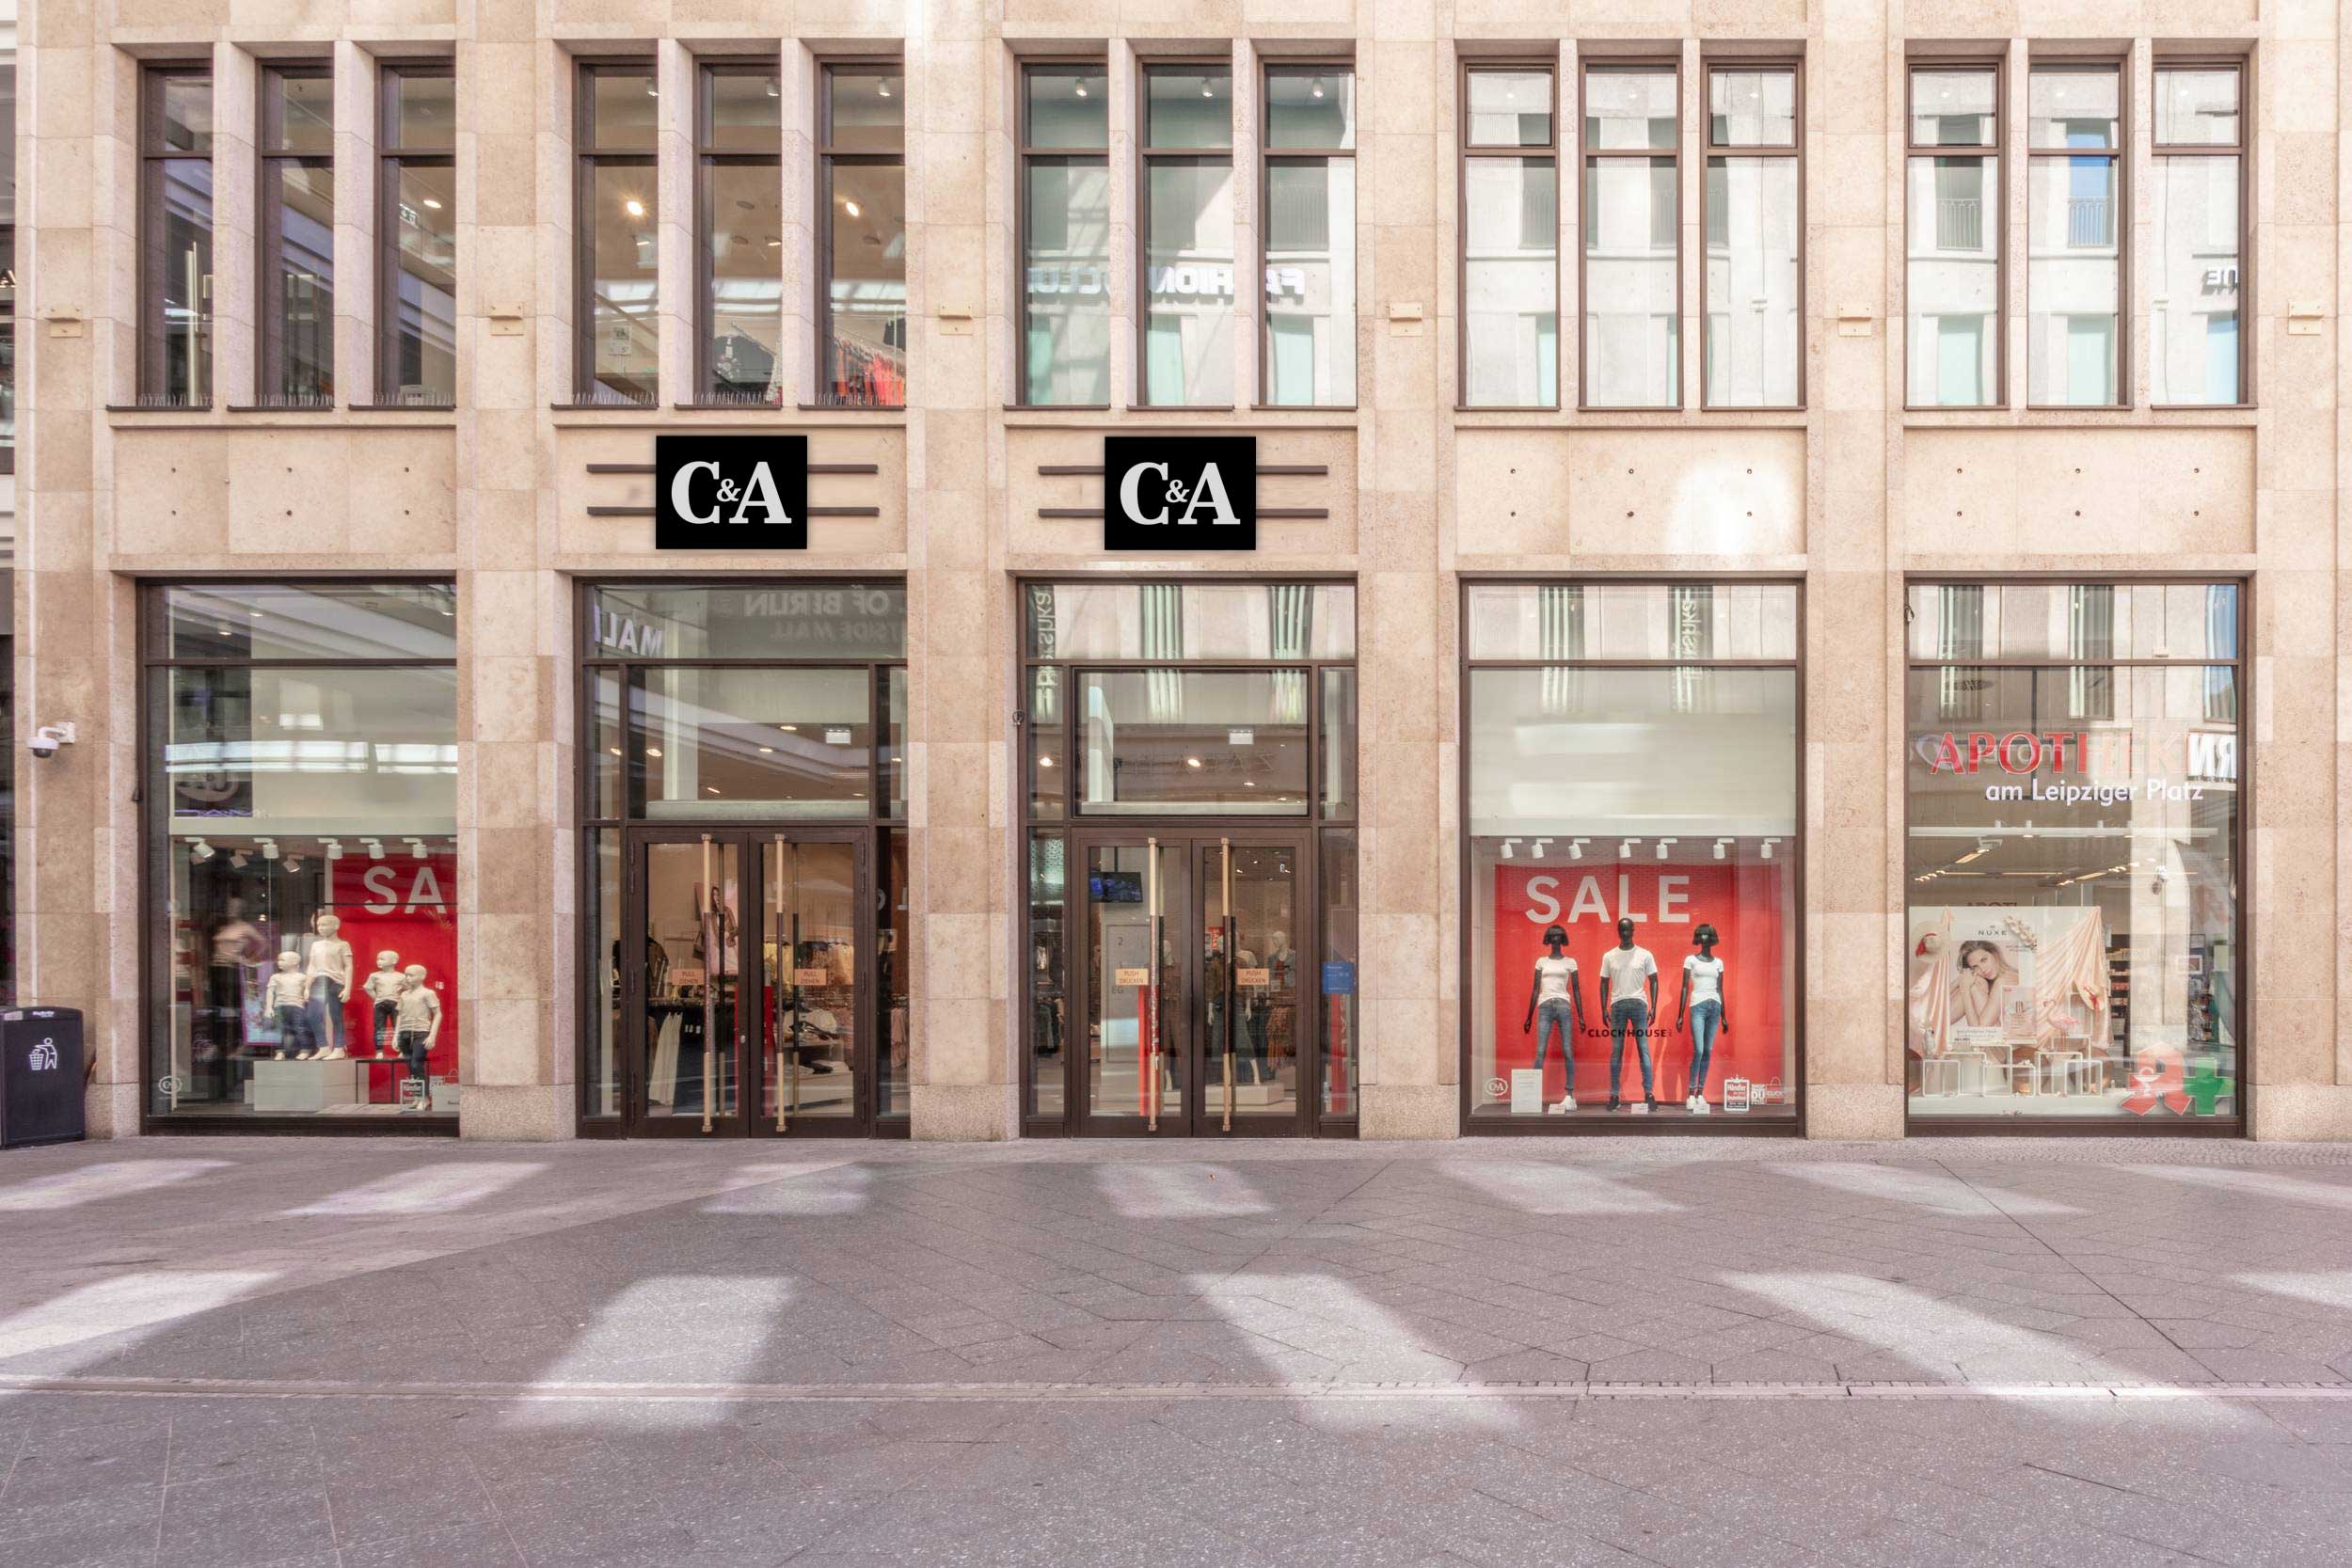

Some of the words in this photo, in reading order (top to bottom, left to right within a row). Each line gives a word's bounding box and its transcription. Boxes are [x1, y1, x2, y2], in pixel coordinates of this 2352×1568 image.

[671, 461, 791, 524] C&A
[1120, 462, 1241, 525] C&A
[1985, 783, 2023, 800] am
[2032, 779, 2138, 807] Leipziger
[2147, 779, 2204, 800] Platz
[1525, 874, 1691, 924] SALE
[1588, 1028, 1667, 1037] CLOCKHOUSE
